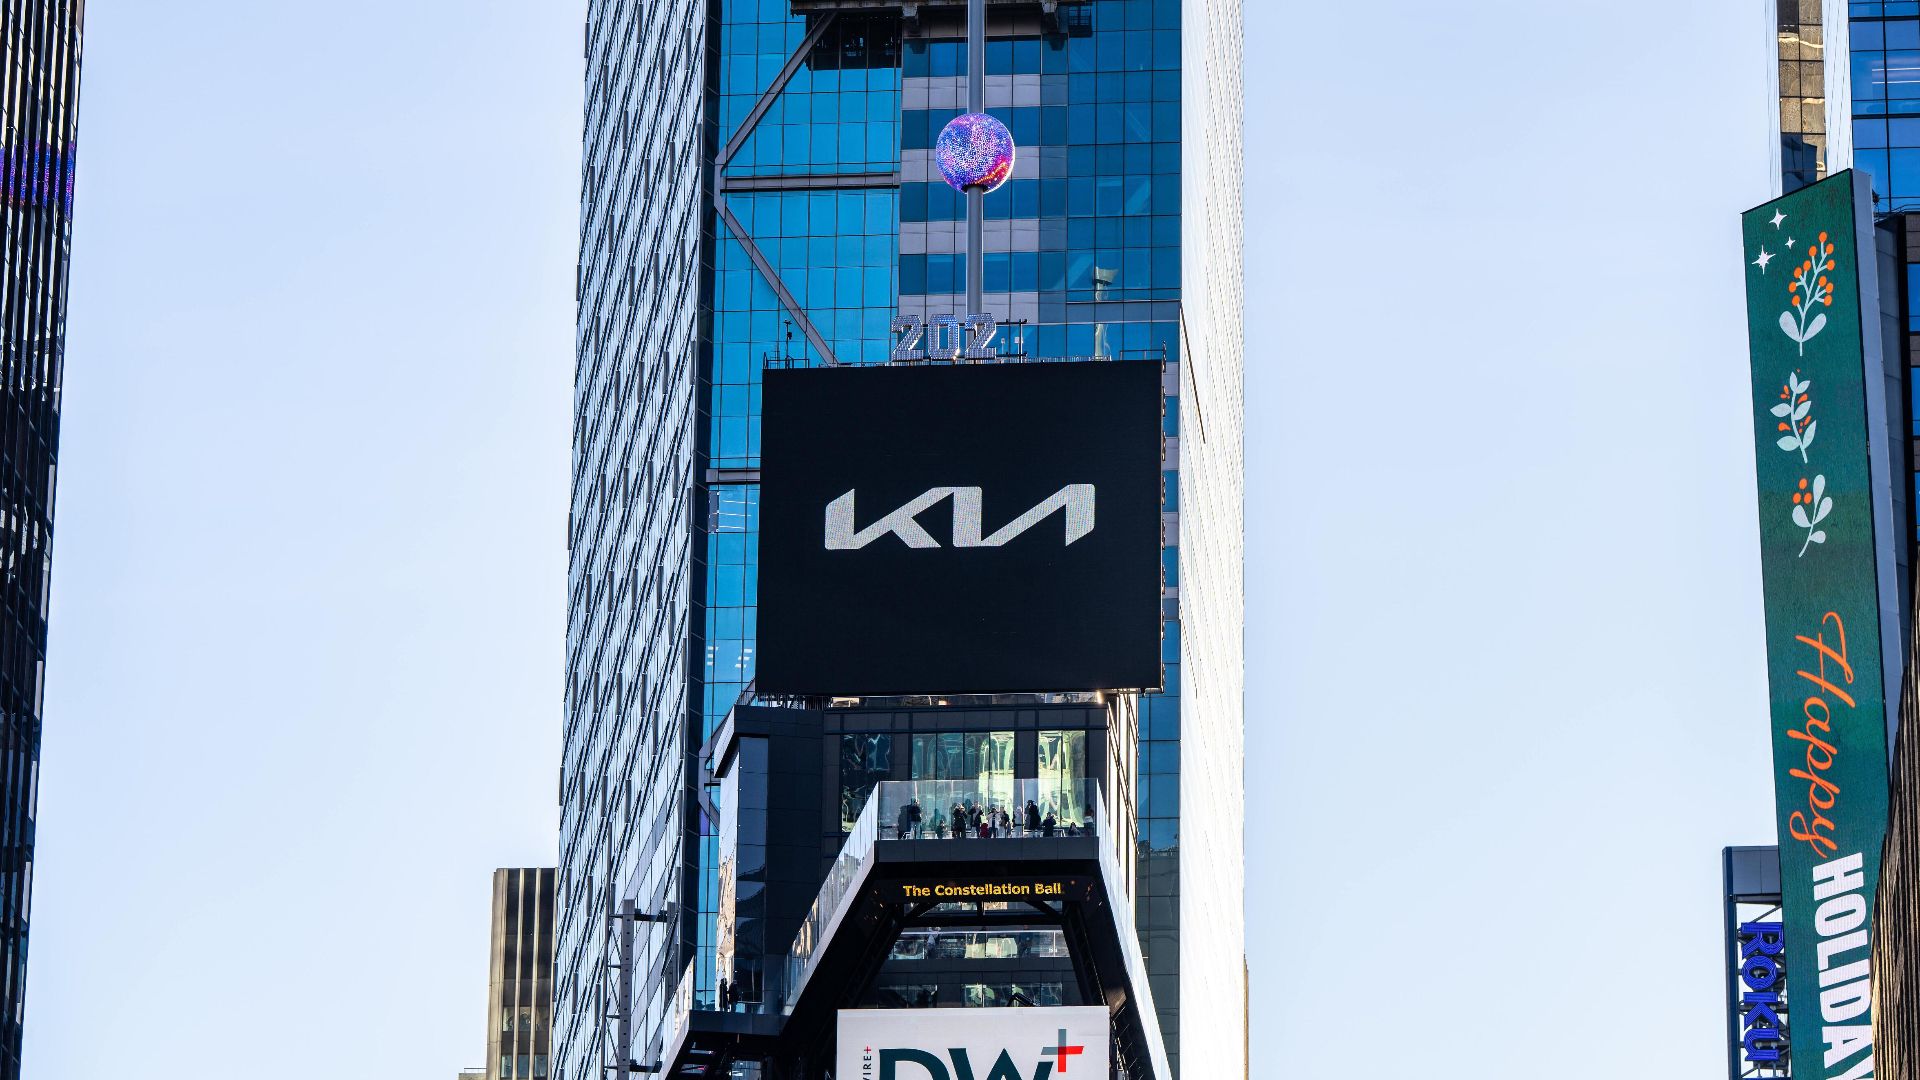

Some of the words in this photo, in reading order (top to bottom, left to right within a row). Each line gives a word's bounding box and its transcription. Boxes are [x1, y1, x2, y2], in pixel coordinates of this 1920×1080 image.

[891, 313, 997, 362] 202
[1787, 611, 1856, 859] Happy
[902, 885, 931, 897] The
[934, 883, 1030, 896] Constellation
[1034, 882, 1063, 895] Ball
